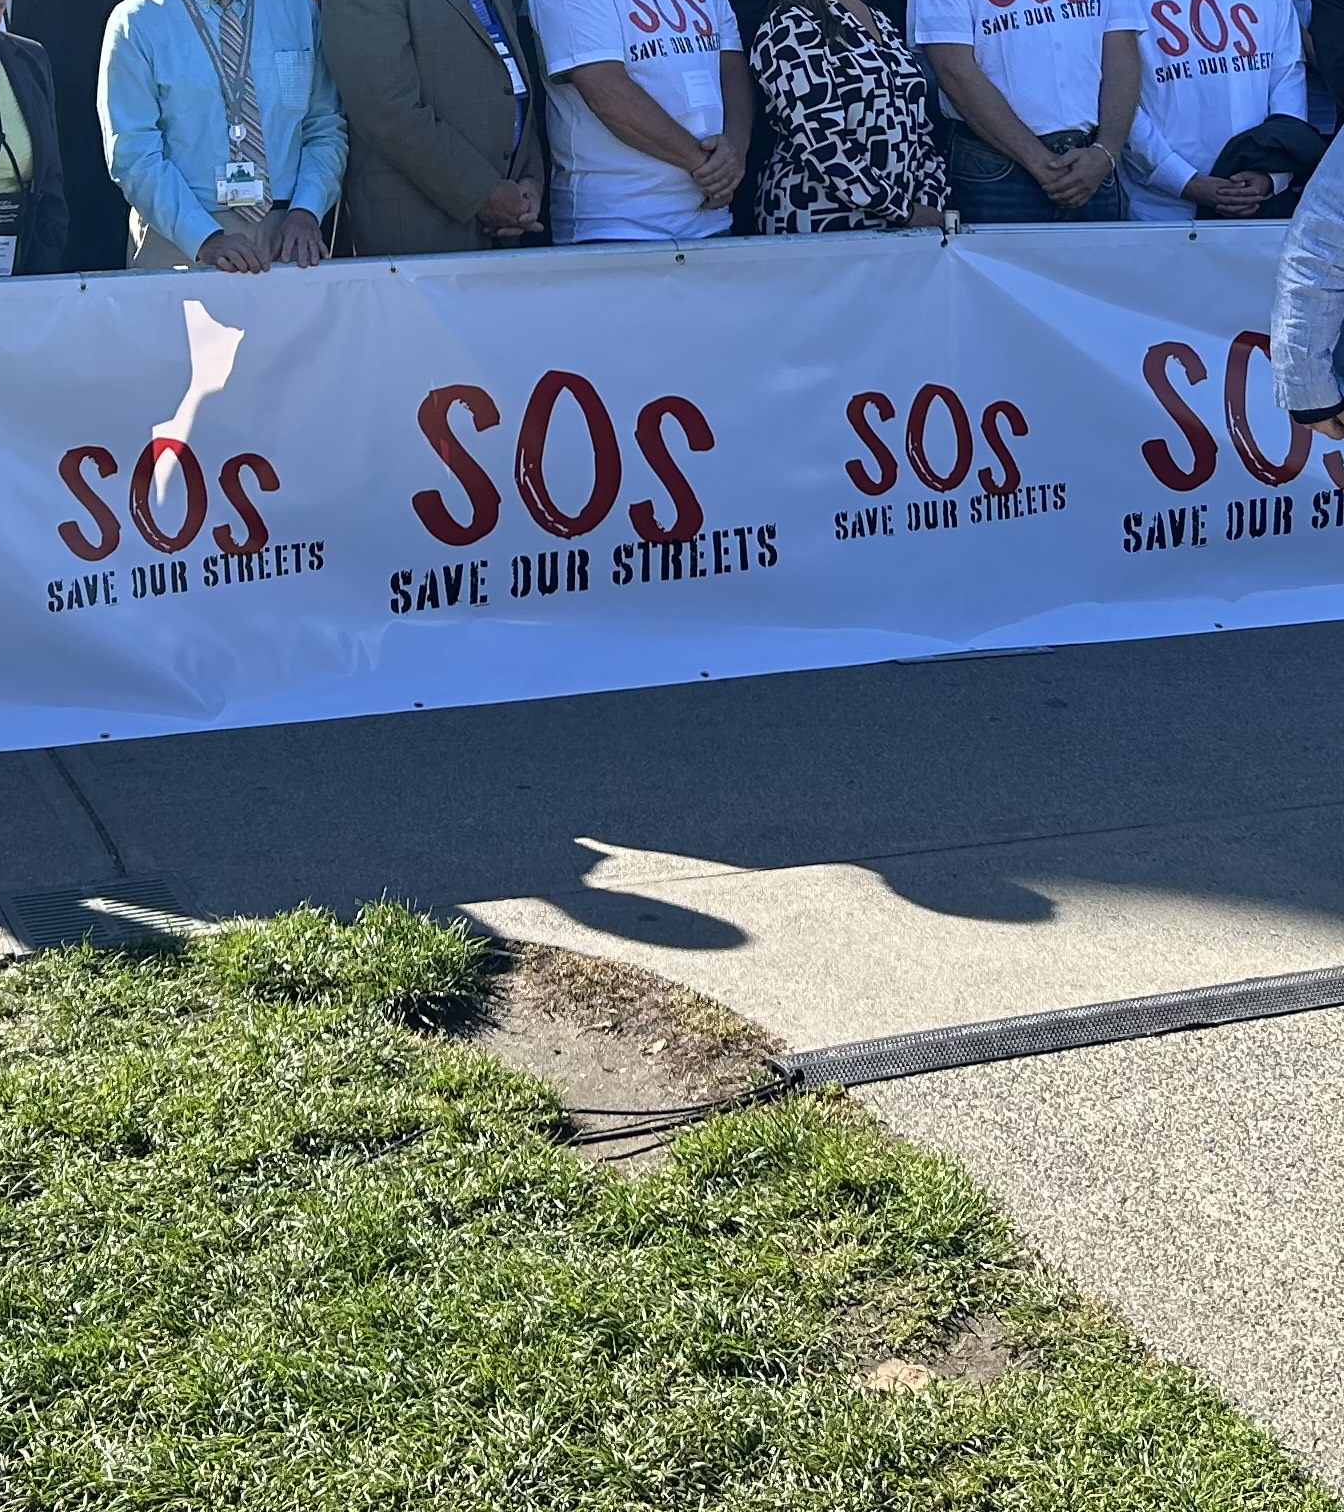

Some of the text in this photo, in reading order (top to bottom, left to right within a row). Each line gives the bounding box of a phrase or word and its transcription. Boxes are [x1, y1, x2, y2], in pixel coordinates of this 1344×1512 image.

[629, 38, 668, 62] SAVE
[670, 36, 695, 54] OUR
[981, 0, 1101, 35] SAVE OUR STREET
[1155, 61, 1193, 83] SAVE
[1198, 56, 1229, 75] OUR
[411, 369, 715, 547] SOS
[845, 383, 1029, 496] SOS
[57, 437, 281, 562] SOS
[834, 482, 1066, 540] SAVE OUR STREETS
[1122, 504, 1208, 554] SAVE
[1225, 495, 1294, 541] OUR
[47, 540, 325, 613] SAVE OUR STREETS
[389, 522, 778, 615] SAVE OUR STREETS
